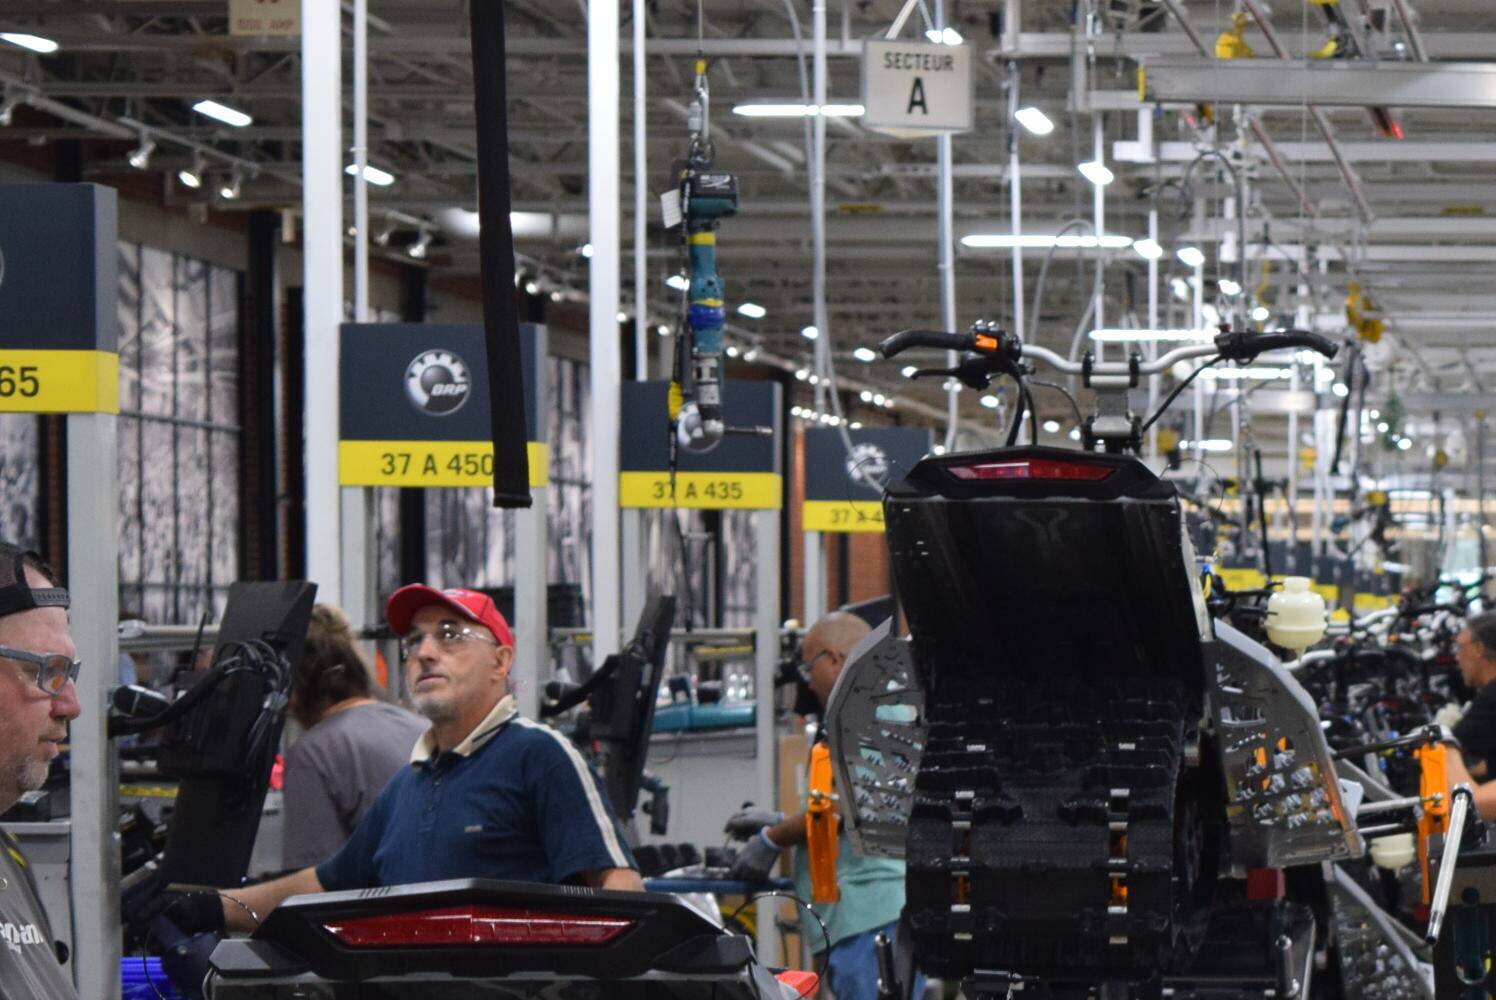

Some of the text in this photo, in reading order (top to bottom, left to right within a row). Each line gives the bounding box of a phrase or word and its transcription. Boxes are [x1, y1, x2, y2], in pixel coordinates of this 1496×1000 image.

[884, 51, 954, 71] SECTEUR
[907, 76, 928, 114] A
[430, 383, 469, 396] BRP
[381, 453, 494, 476] 37 A 450
[685, 482, 697, 498] A
[704, 481, 743, 499] 435
[831, 508, 850, 523] 37
